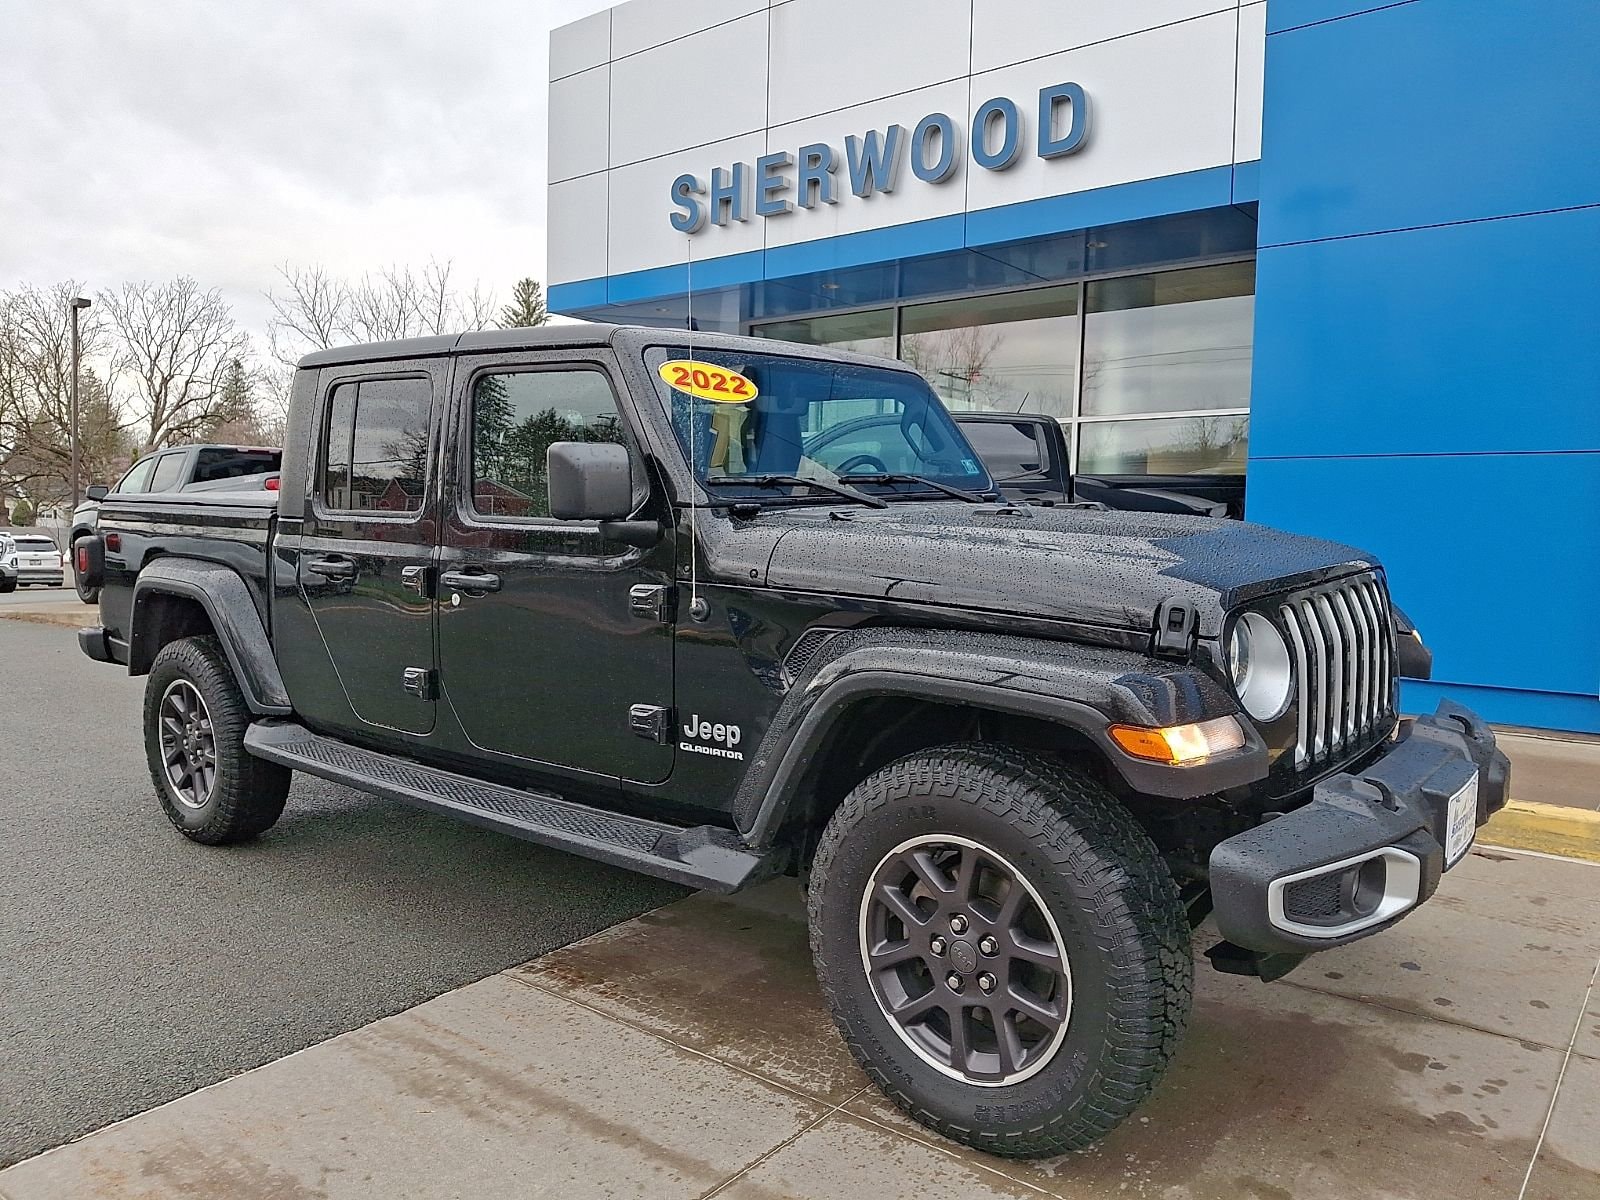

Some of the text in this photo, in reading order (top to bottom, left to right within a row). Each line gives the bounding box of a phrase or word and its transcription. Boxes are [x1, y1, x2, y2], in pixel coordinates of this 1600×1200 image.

[669, 81, 1094, 234] SHERWOOD
[672, 366, 748, 396] 2022
[683, 714, 740, 748] Jeep
[679, 742, 743, 760] GLADIATOR
